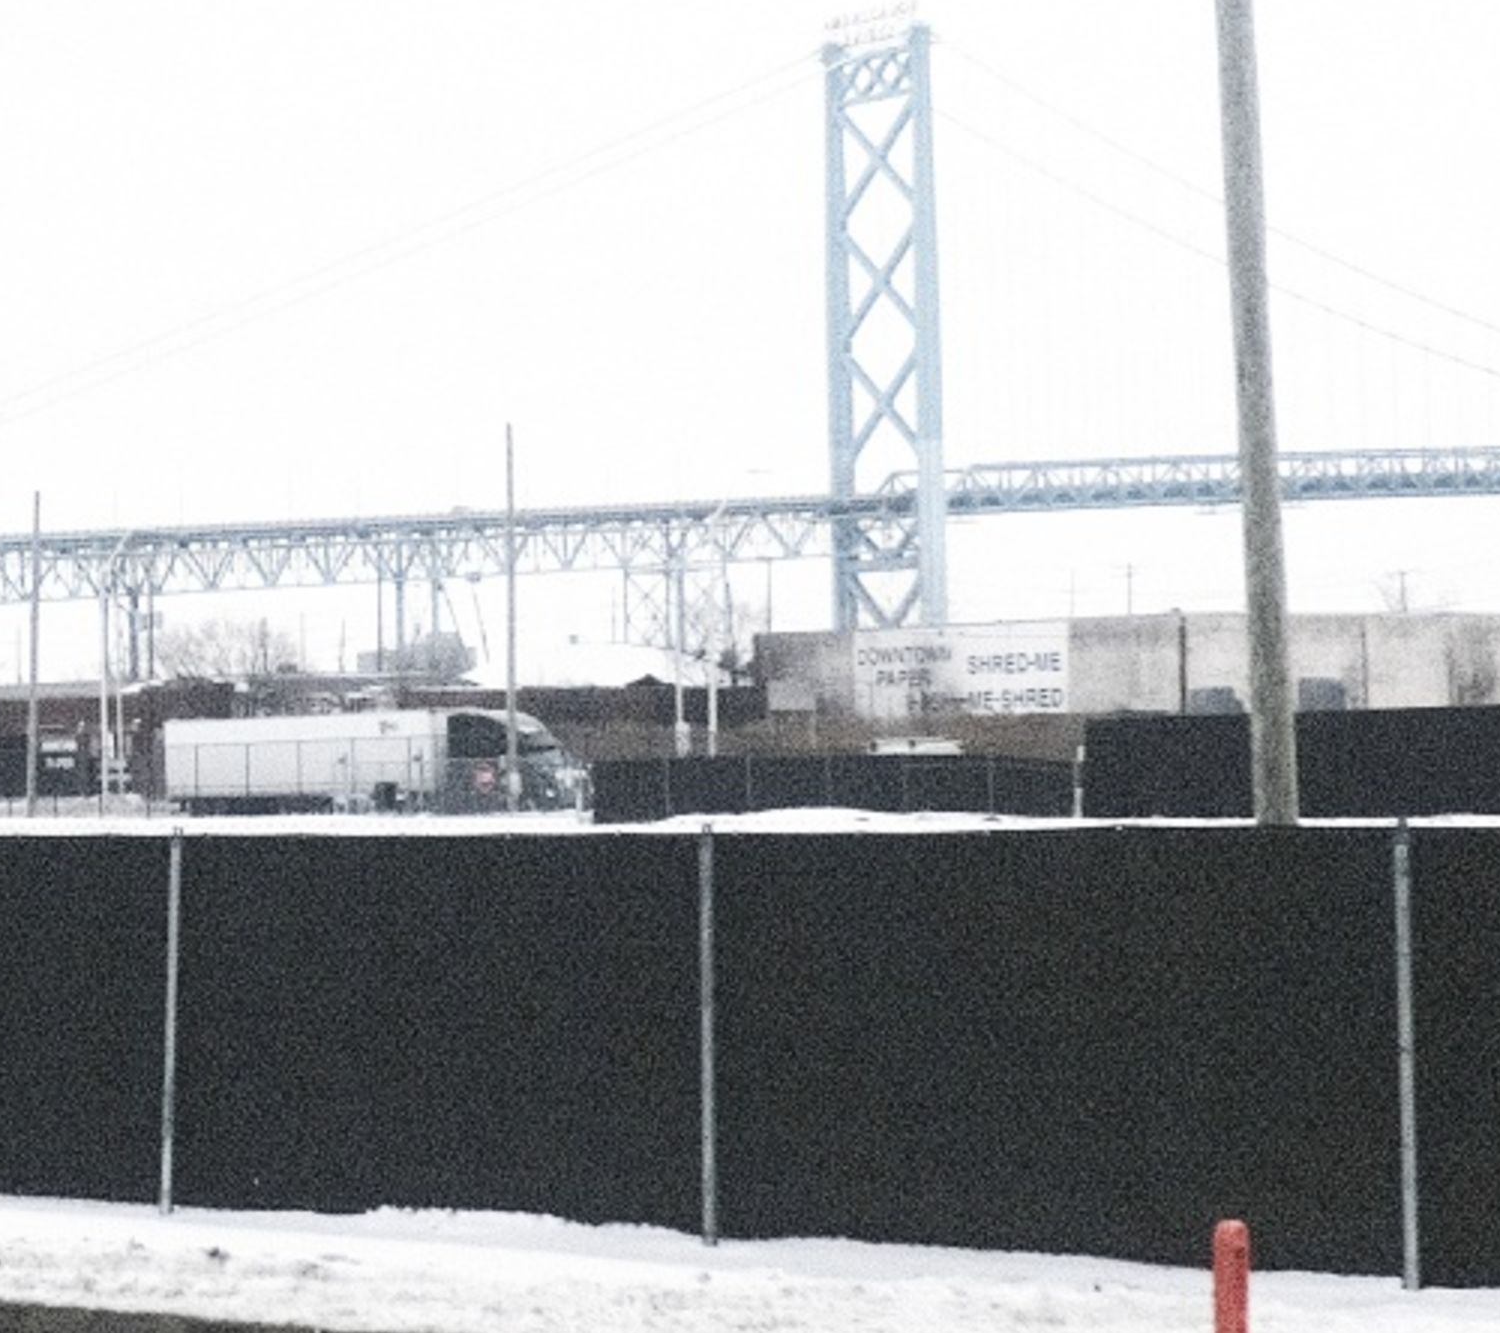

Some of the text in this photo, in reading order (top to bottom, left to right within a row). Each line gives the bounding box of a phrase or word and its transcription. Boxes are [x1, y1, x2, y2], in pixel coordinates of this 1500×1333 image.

[857, 645, 953, 666] DOWNTOWN
[966, 651, 1062, 675] SHRED-ME
[967, 687, 1065, 710] ME-SHRED
